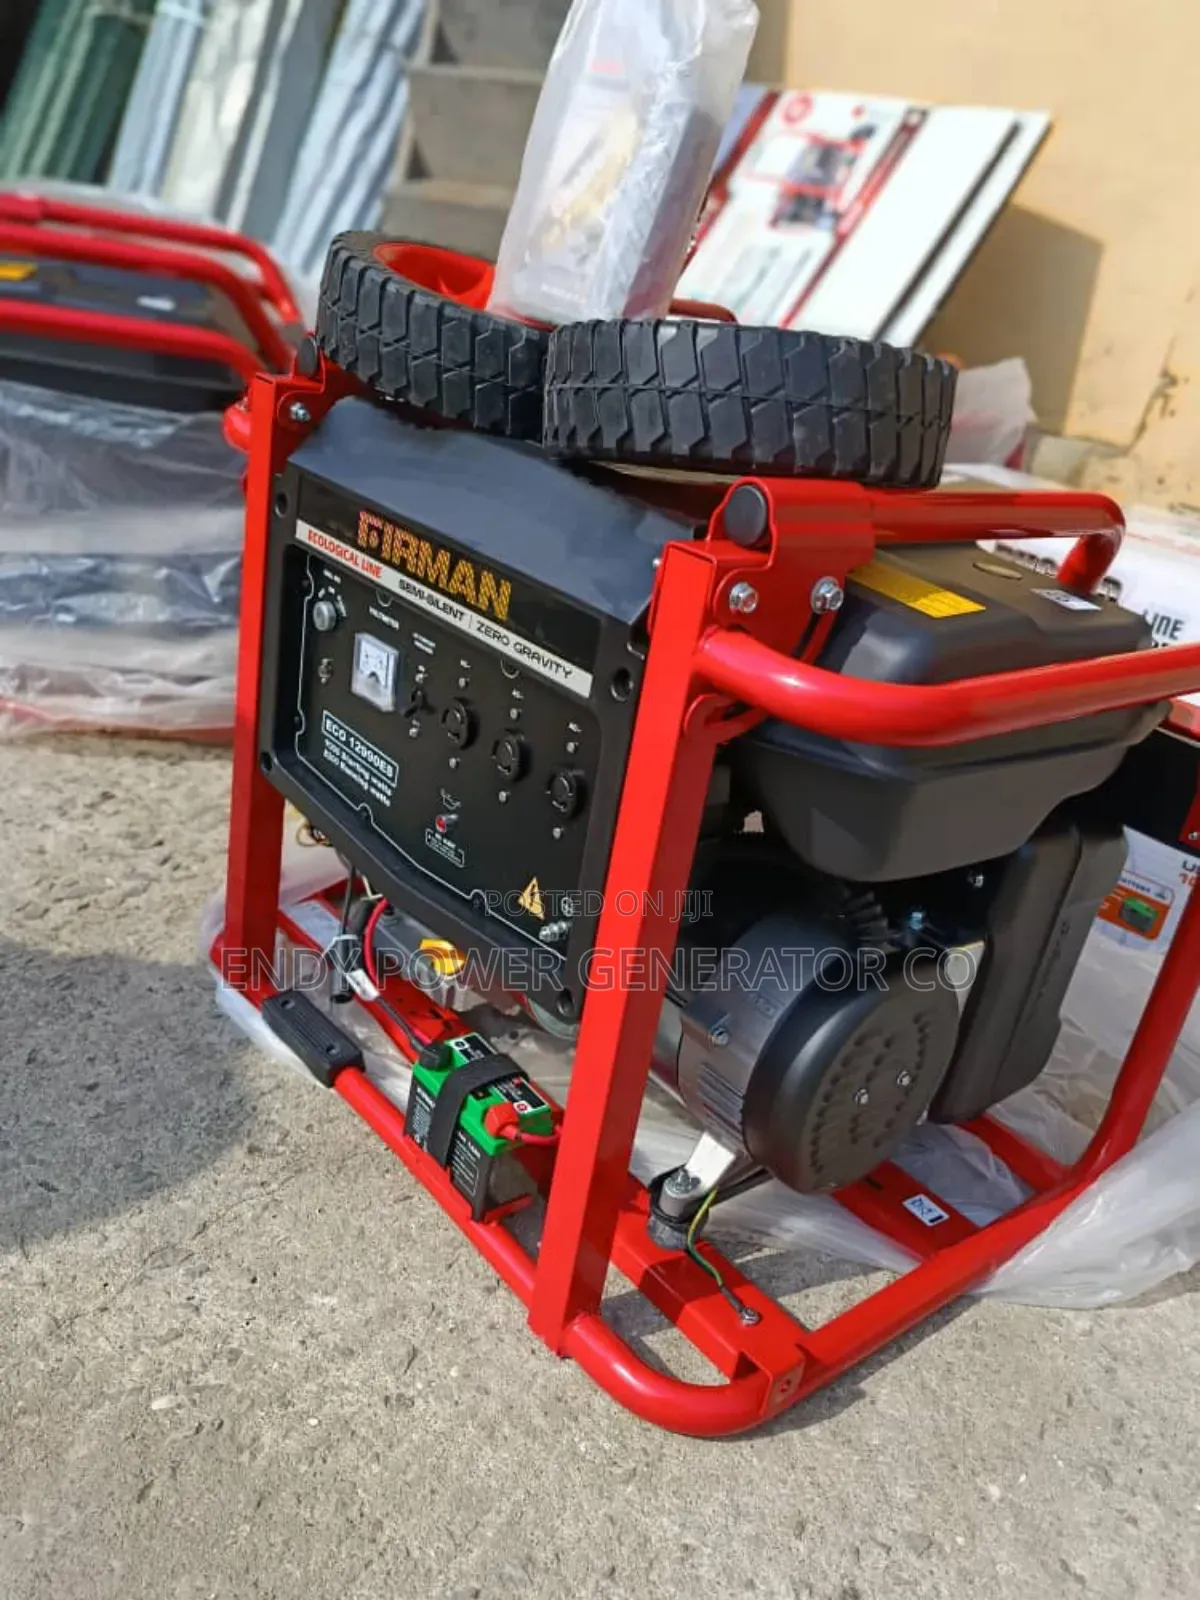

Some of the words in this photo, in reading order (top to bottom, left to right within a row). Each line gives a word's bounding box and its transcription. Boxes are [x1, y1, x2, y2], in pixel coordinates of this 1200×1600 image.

[307, 529, 360, 569] ECOLOGICAL
[361, 557, 384, 578] LINE
[357, 510, 512, 622] FIRMAN
[399, 578, 466, 623] SEMI-SILENT
[476, 619, 510, 648] ZERO
[512, 641, 574, 680] GRAVITY
[1143, 607, 1184, 641] INE
[325, 718, 347, 742] ECO
